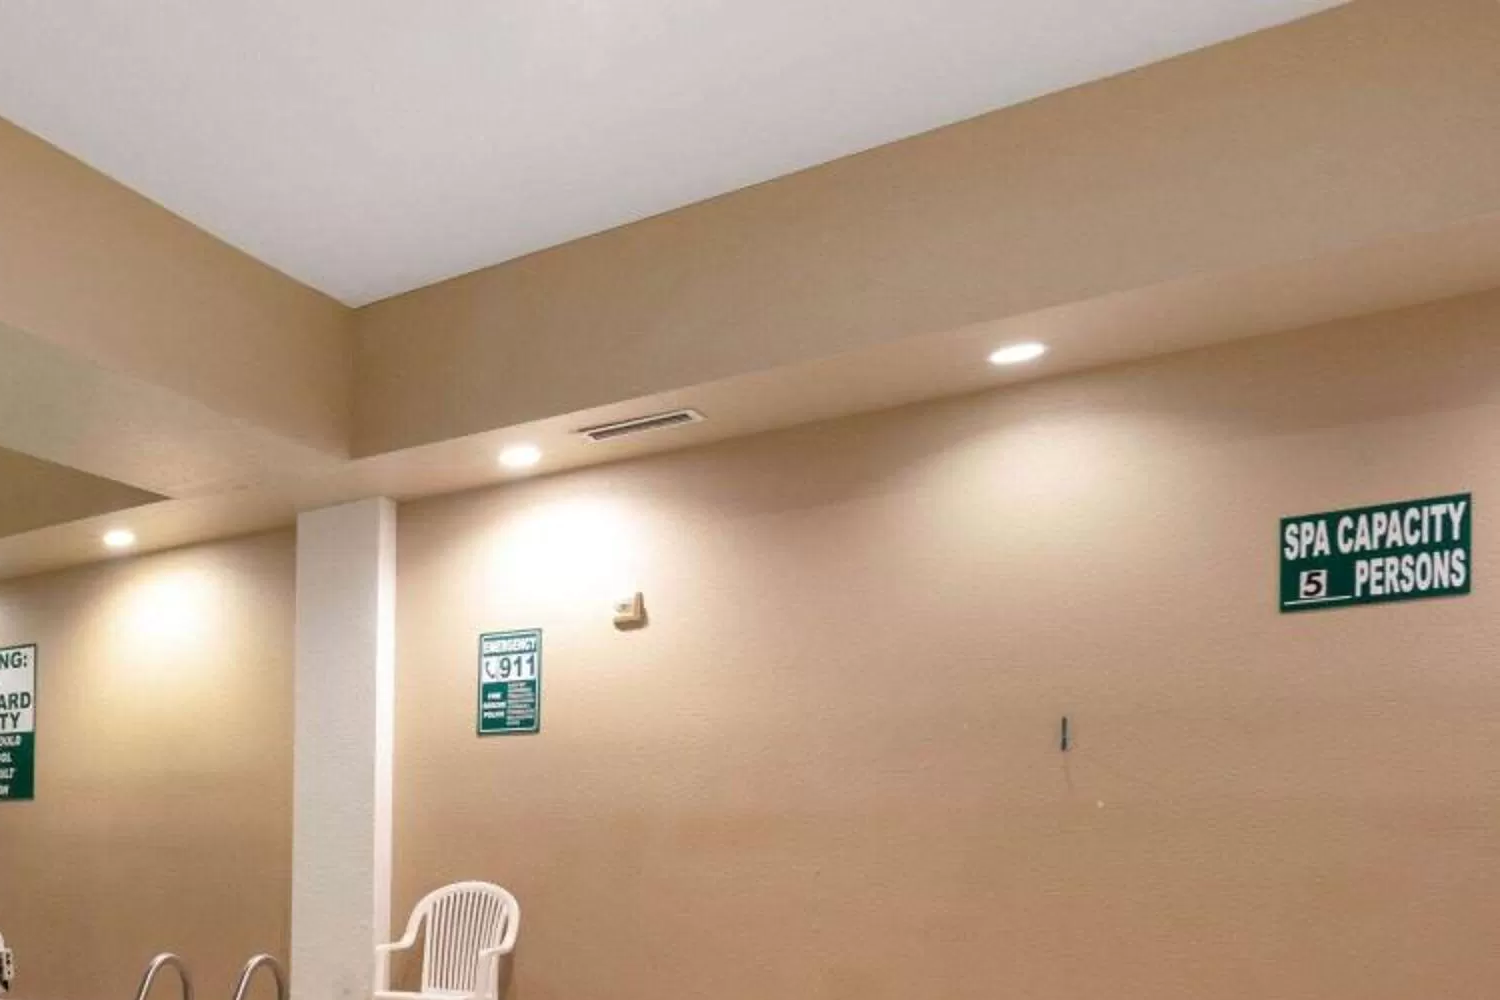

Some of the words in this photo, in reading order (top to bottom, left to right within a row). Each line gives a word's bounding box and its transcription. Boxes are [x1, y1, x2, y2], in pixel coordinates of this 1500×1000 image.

[1283, 519, 1330, 560] SPA
[1337, 501, 1466, 554] CAPACITY
[1303, 571, 1322, 596] 5
[1355, 548, 1466, 597] PERSONS
[500, 655, 535, 678] 911
